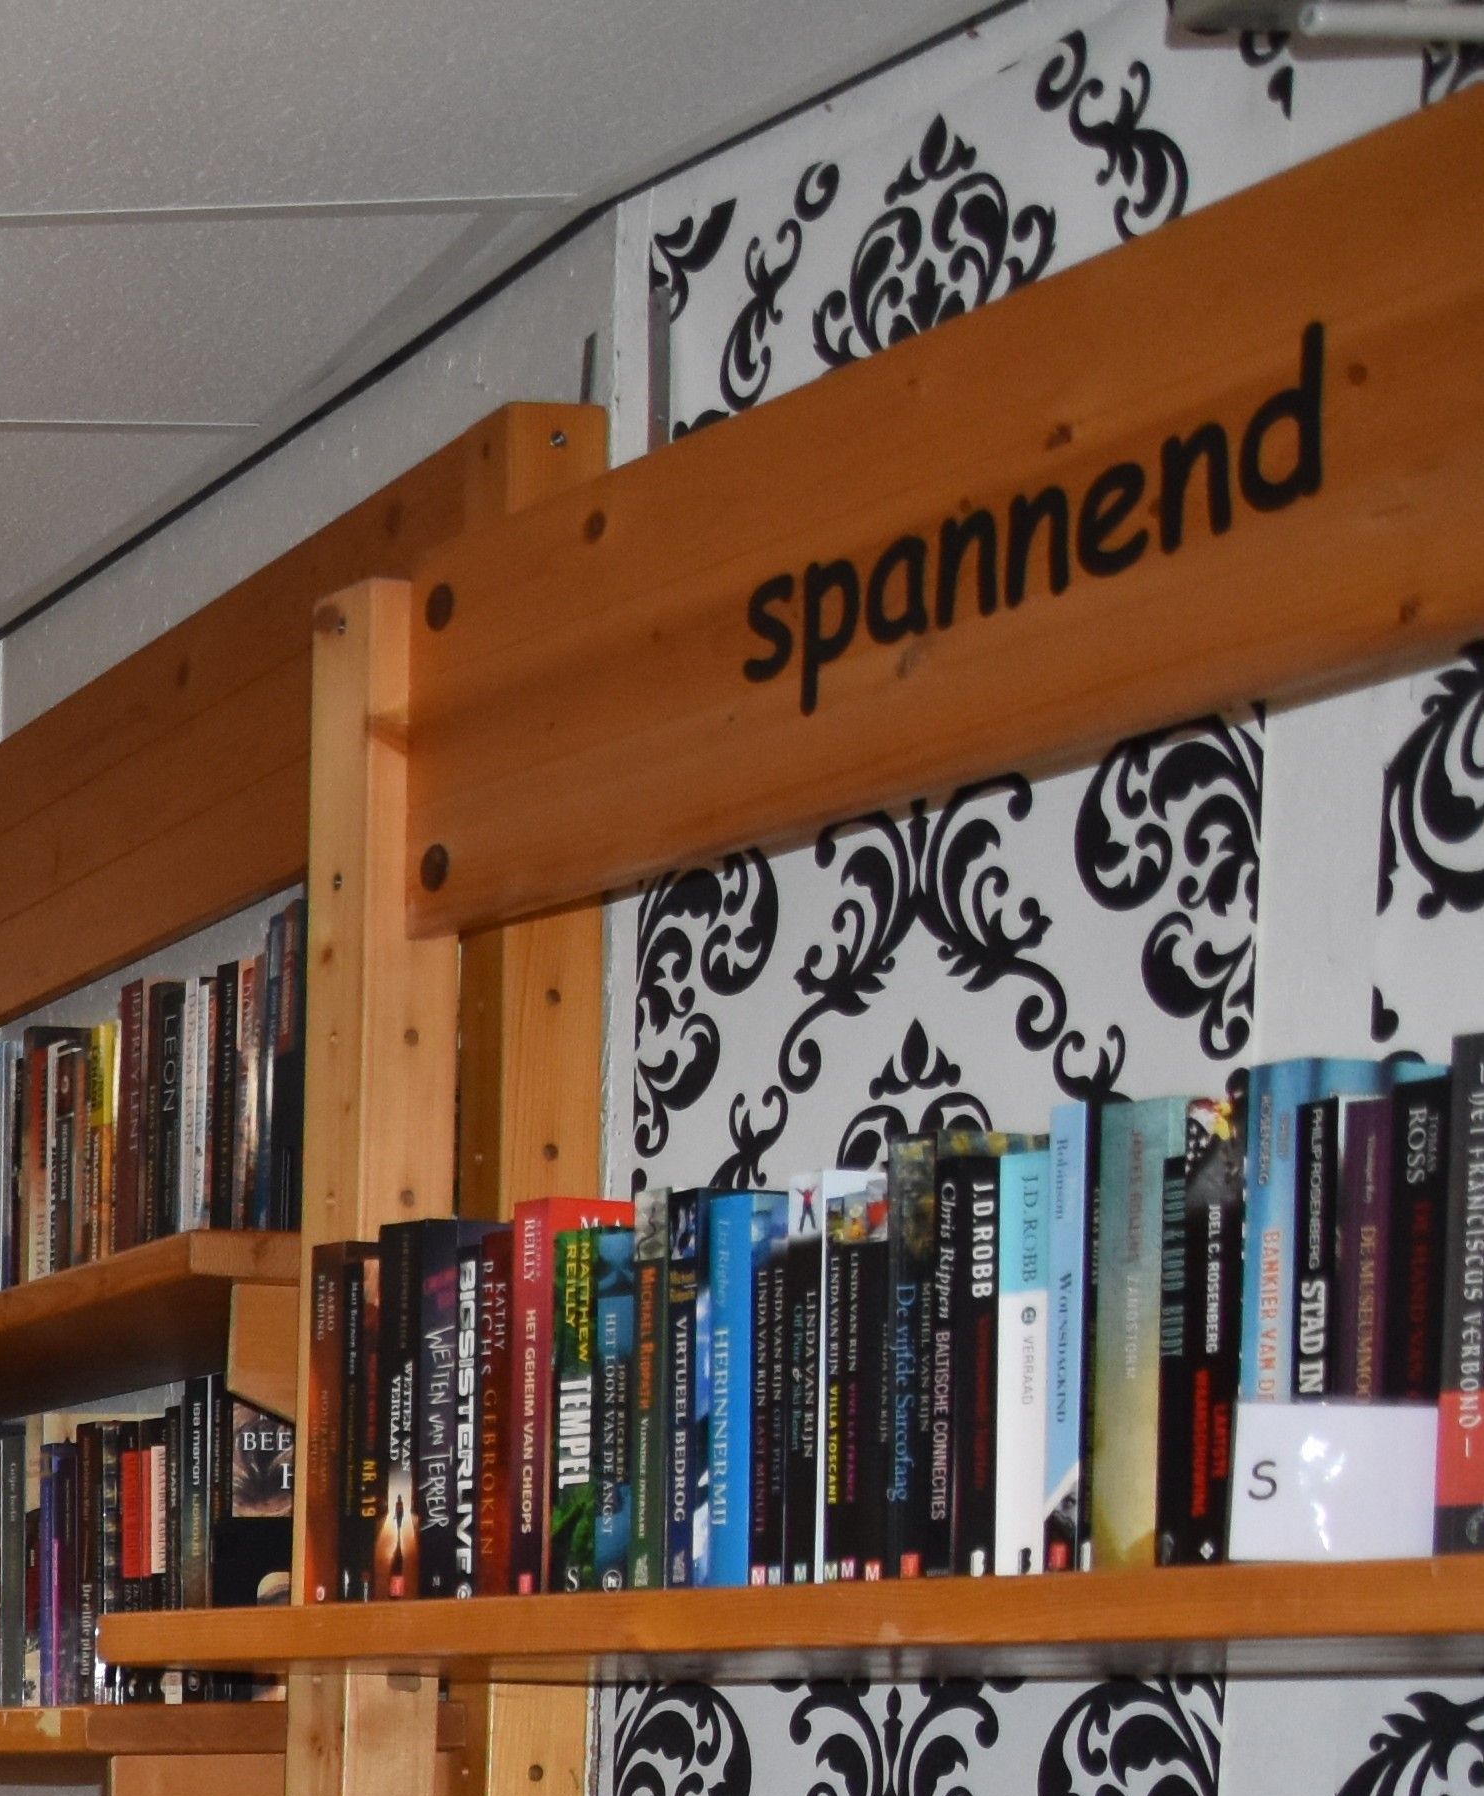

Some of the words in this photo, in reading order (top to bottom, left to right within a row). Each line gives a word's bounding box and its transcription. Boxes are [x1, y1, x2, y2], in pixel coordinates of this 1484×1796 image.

[742, 320, 1325, 716] spannend
[162, 1014, 177, 1112] LEON
[526, 1309, 537, 1343] HET
[565, 1243, 577, 1327] REILLY
[578, 1242, 591, 1363] MATTHEW
[1299, 1279, 1327, 1350] STAD
[525, 1348, 537, 1417] GEHEIM
[674, 1315, 688, 1426] VIRTUEEL
[712, 1327, 729, 1480] HERINNER
[933, 1330, 951, 1415] BALTISCHE
[1298, 1355, 1325, 1395] IN
[523, 1420, 535, 1461] VAN
[558, 1375, 593, 1491] TEMPEL
[931, 1419, 948, 1522] CONNECTIES
[521, 1464, 533, 1534] CHEOPS
[673, 1429, 686, 1523] BEDROG
[711, 1482, 727, 1528] MIJ
[1247, 1459, 1278, 1501] S
